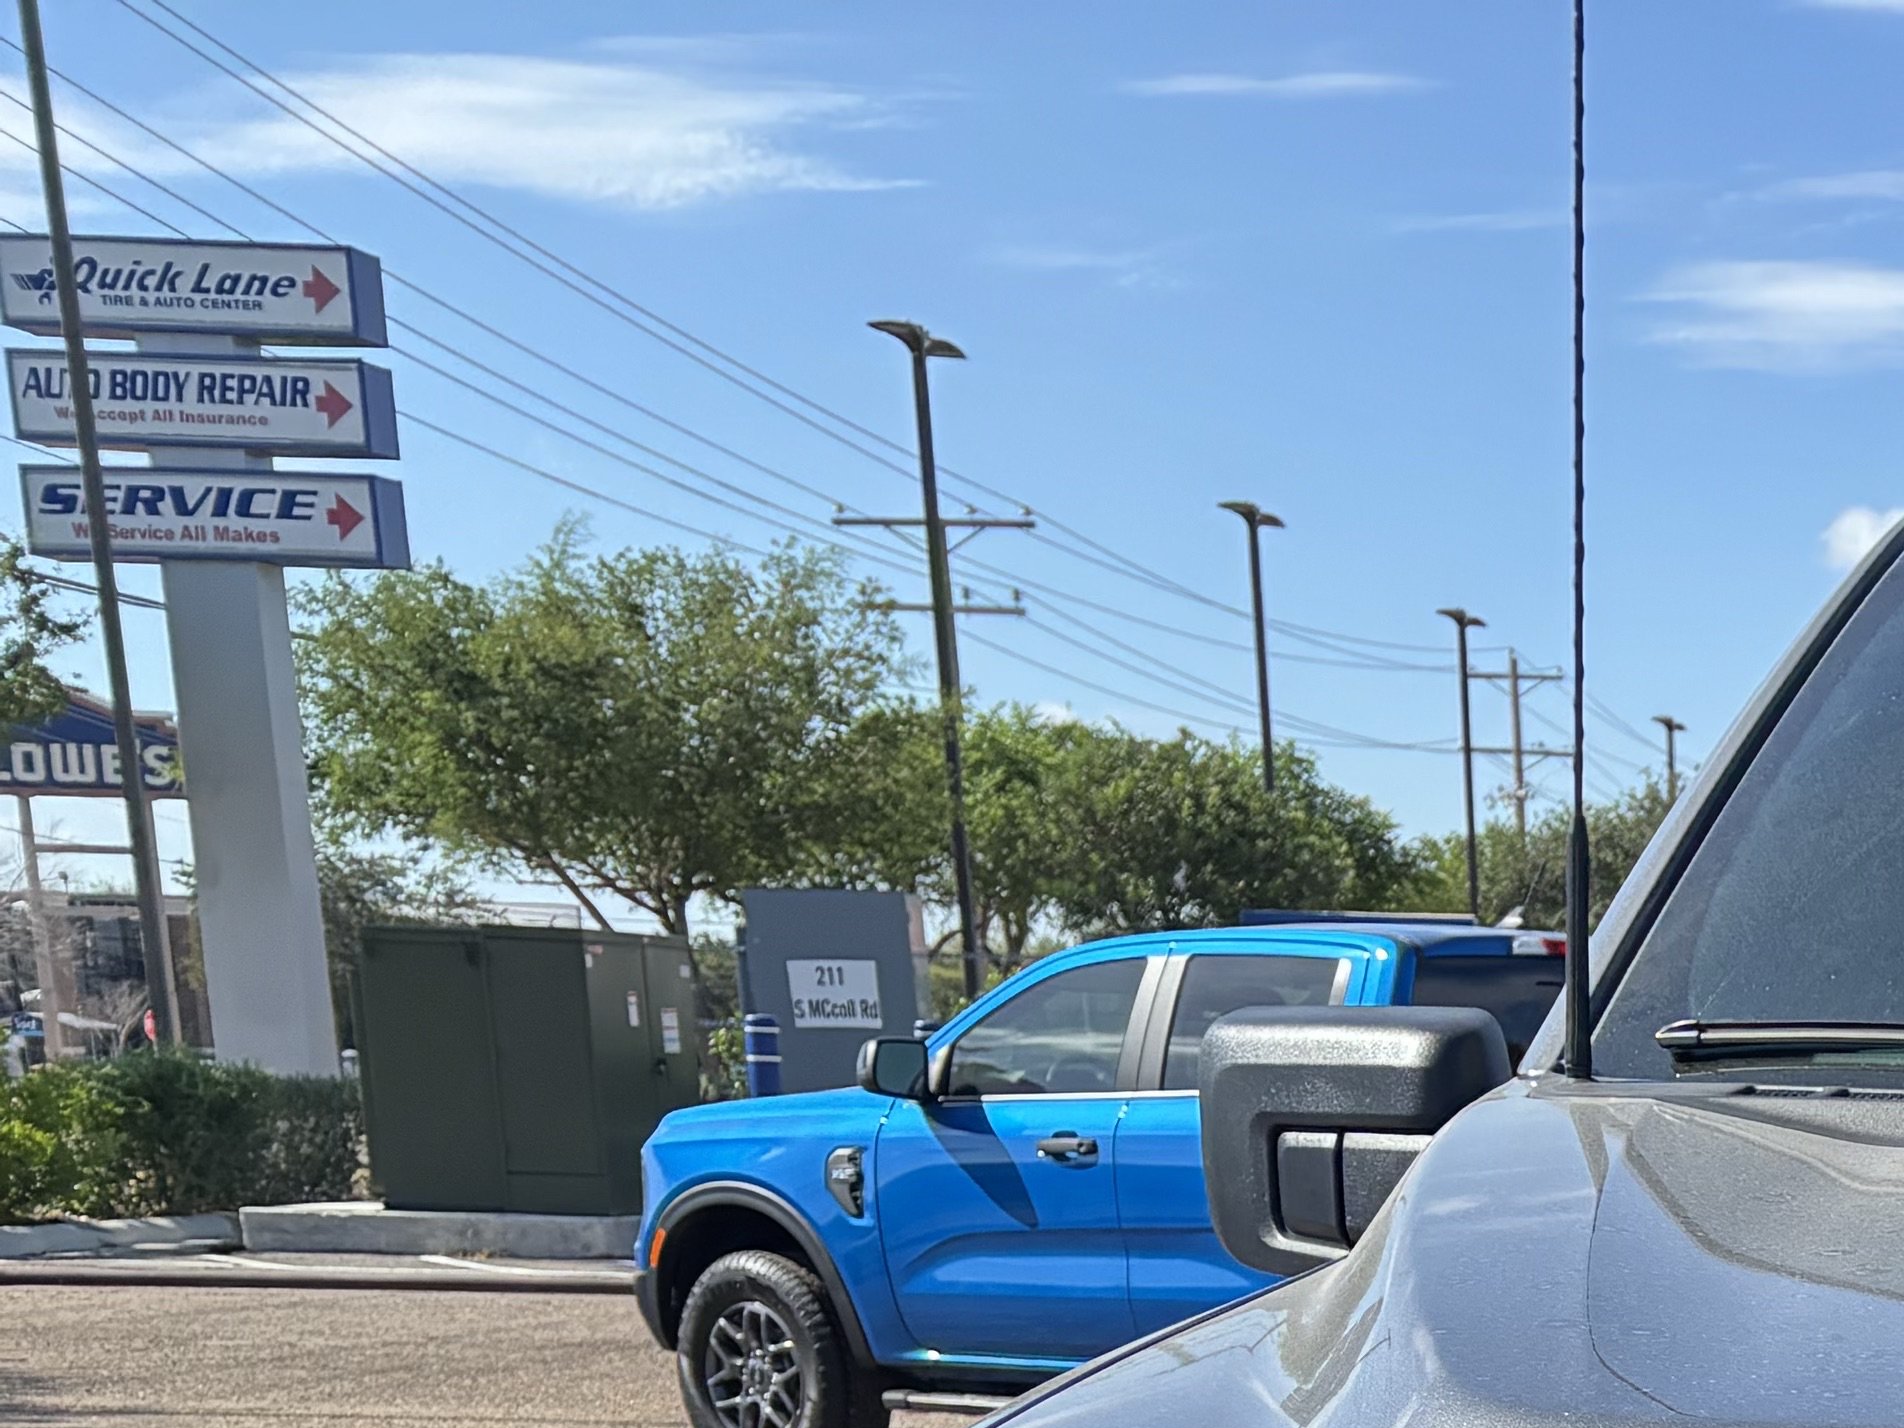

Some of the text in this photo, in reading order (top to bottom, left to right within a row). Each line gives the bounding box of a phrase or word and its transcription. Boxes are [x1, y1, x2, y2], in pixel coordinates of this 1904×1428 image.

[73, 256, 297, 298] Quick Lane
[100, 294, 263, 311] TIRE & AUTO CENTER
[108, 369, 191, 403] BODY
[197, 372, 310, 408] REPAIR
[95, 408, 146, 425] ccept
[152, 409, 174, 423] All
[179, 410, 269, 426] Insurance
[180, 524, 207, 542] All
[213, 525, 280, 544] Makes
[0, 738, 179, 787] OWE'S
[815, 966, 844, 987] 211
[793, 998, 806, 1019] S
[860, 998, 879, 1019] Rd
